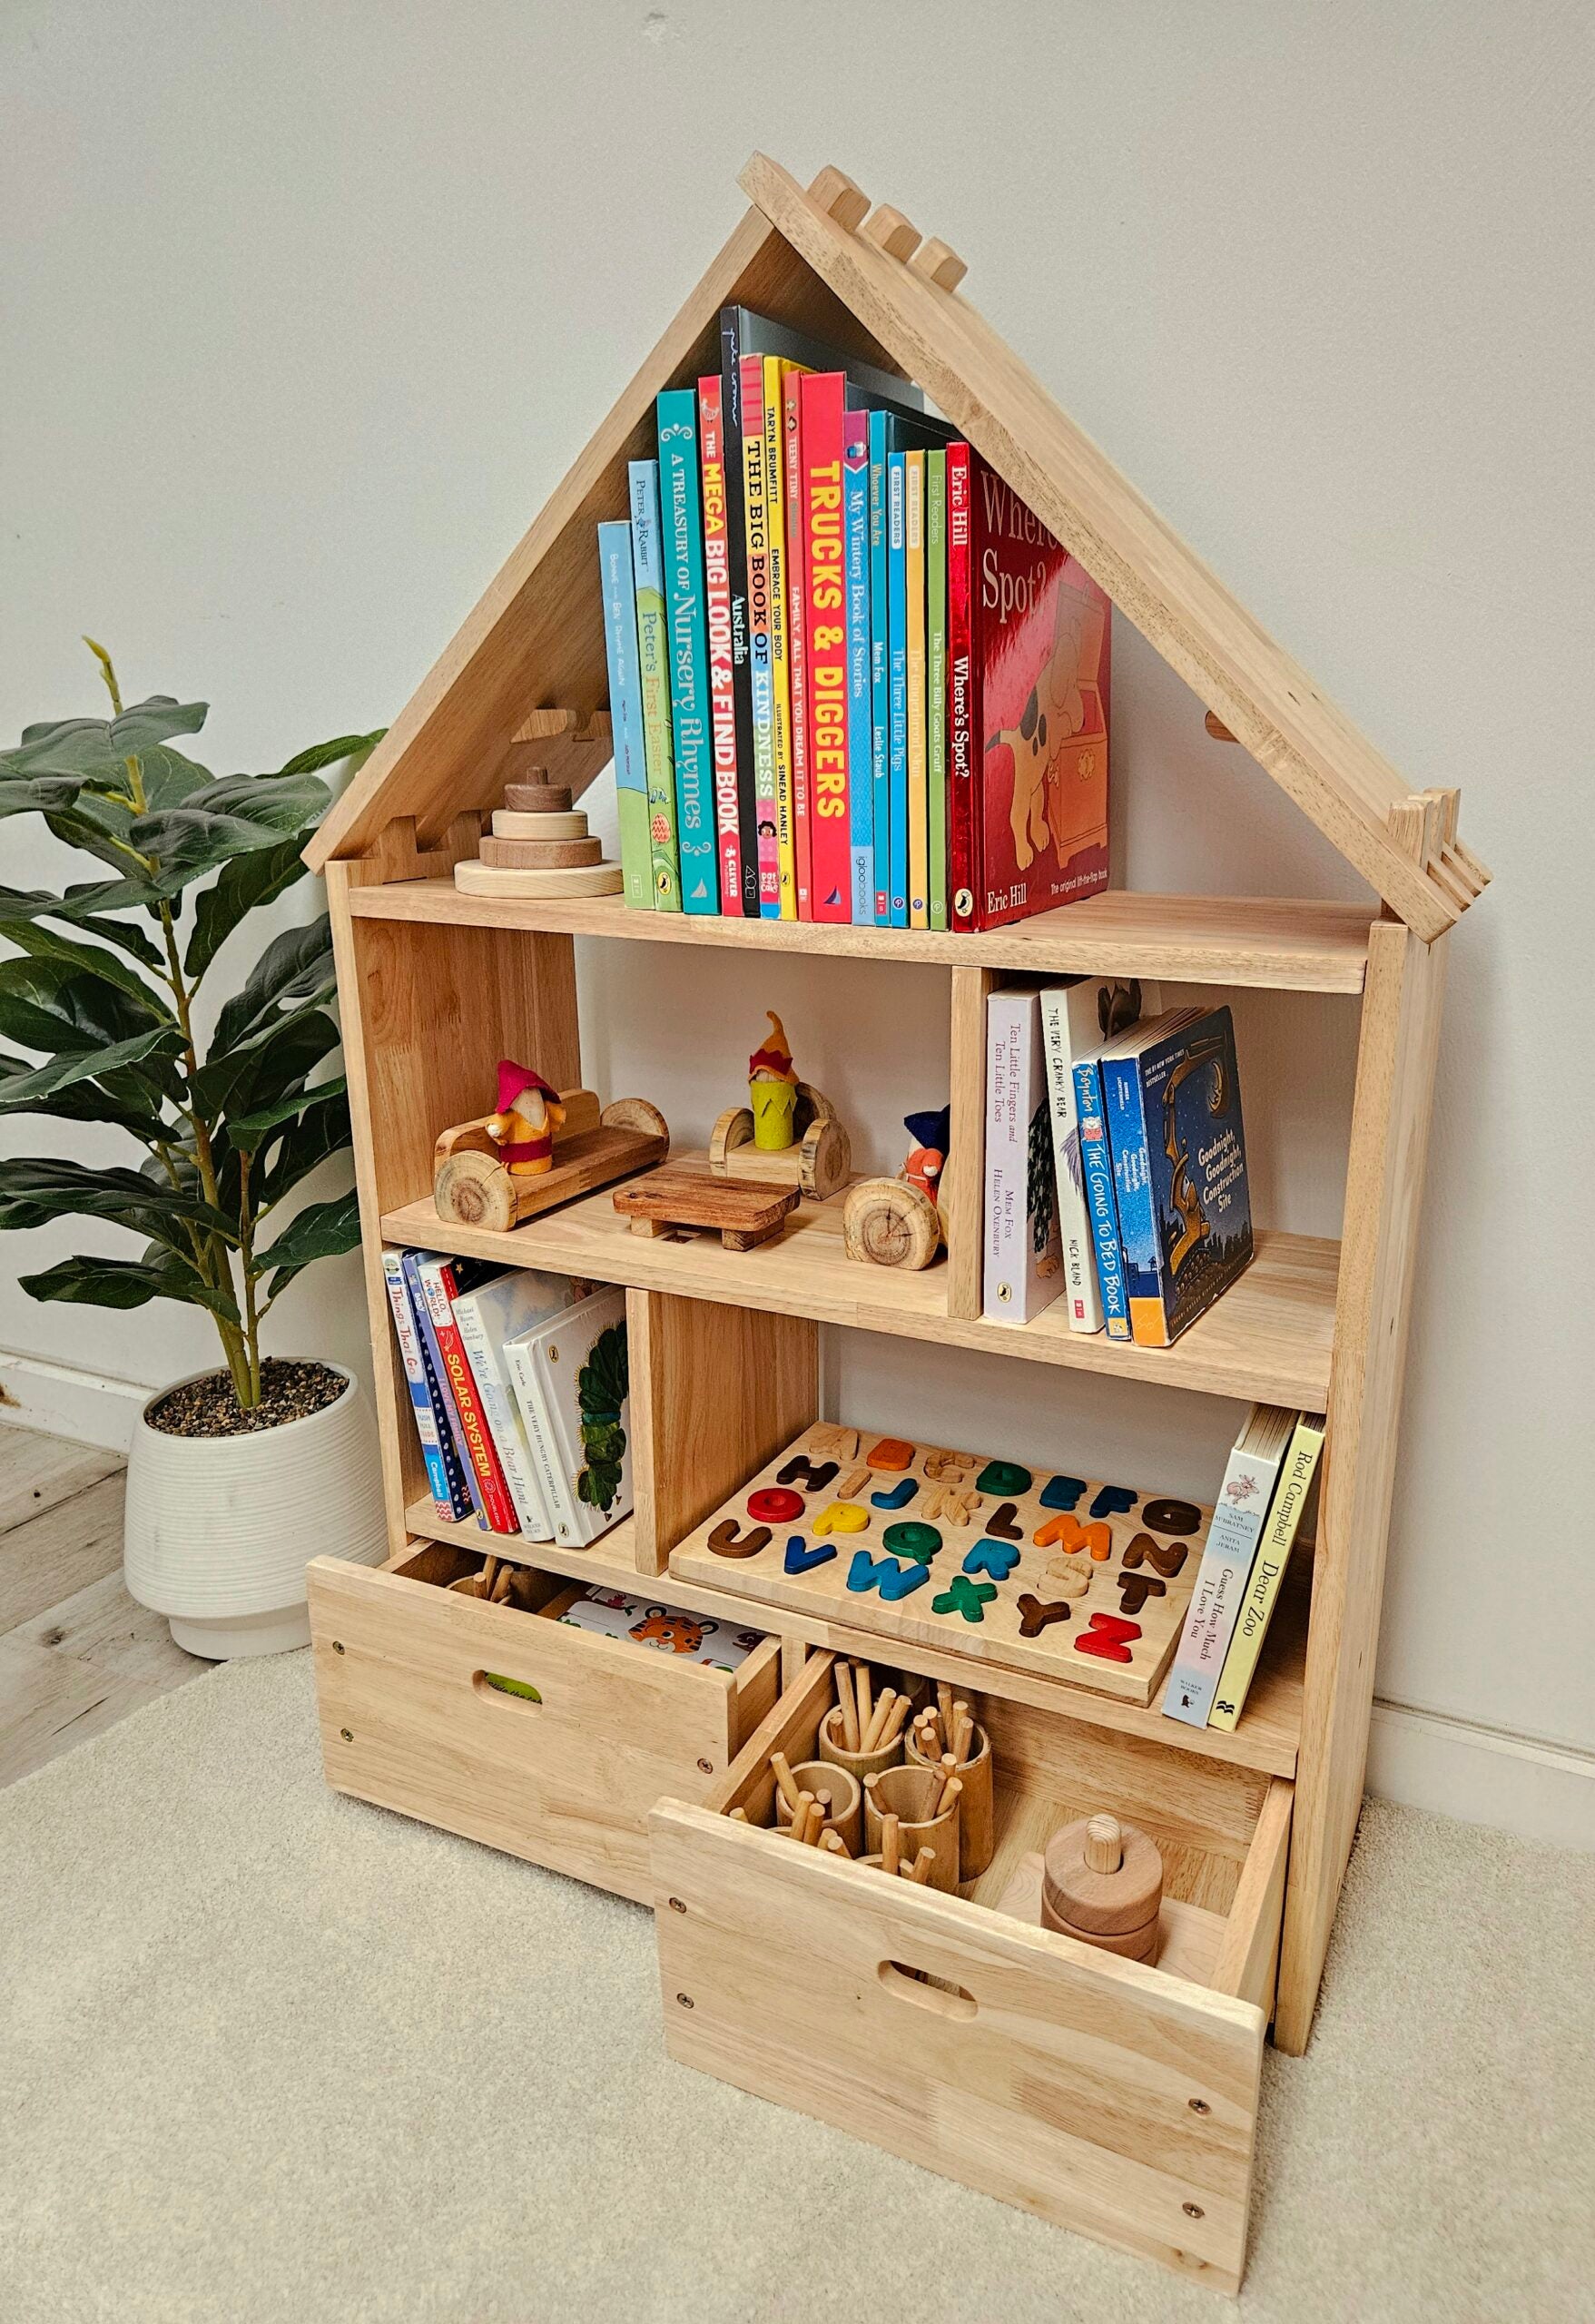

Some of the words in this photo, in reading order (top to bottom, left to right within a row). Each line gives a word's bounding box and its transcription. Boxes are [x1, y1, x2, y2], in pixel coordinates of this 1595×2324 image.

[767, 408, 776, 441] TARYN
[672, 454, 684, 465] A
[704, 431, 715, 458] THE
[788, 436, 797, 469] TEENY
[747, 441, 762, 497] THE
[769, 448, 778, 504] BRUMFITT
[871, 464, 882, 507] Whoever
[932, 475, 941, 496] First
[635, 480, 645, 516] PETER
[704, 464, 724, 535] MEGA
[789, 474, 798, 499] TINY
[850, 492, 863, 514] My
[952, 466, 967, 507] Eric
[672, 468, 690, 562] TREASURY
[751, 505, 763, 550] BIG
[872, 508, 882, 527] You
[932, 500, 941, 544] Readers
[953, 511, 968, 546] Hill
[639, 530, 648, 566] RABBIT
[810, 461, 842, 610] TRUCKS
[850, 517, 864, 579] Wintery
[872, 530, 882, 546] Are
[676, 567, 690, 590] OF
[704, 540, 727, 584] BIG
[772, 549, 780, 600] EMBRACE
[753, 556, 766, 626] BOOK
[983, 548, 1047, 624] Spot?
[852, 586, 864, 624] Book
[643, 612, 656, 672] Peter's
[708, 593, 732, 663] LOOK
[733, 594, 748, 665] Australia
[814, 625, 843, 651] &
[852, 632, 864, 642] of
[933, 631, 941, 650] The
[674, 593, 696, 712] Nursery
[754, 633, 767, 664] OF
[793, 639, 801, 663] ALL
[874, 642, 883, 664] Mem
[893, 648, 904, 672] The
[712, 665, 733, 690] &
[793, 667, 802, 697] THAT
[853, 648, 866, 698] Stories
[874, 667, 884, 684] Fox
[933, 654, 941, 683] Three
[645, 676, 659, 716] First
[893, 674, 904, 710] Three
[931, 686, 941, 710] Billy
[954, 656, 969, 726] Where's
[793, 701, 802, 724] YOU
[893, 713, 904, 744] Little
[713, 694, 736, 765] FIND
[755, 670, 773, 797] KINDNESS
[794, 725, 804, 767] DREAM
[814, 666, 846, 817] DIGGERS
[874, 726, 884, 752] Leslie
[648, 724, 661, 774] Easter
[891, 748, 904, 772] Pigs
[952, 731, 970, 778] Spot?
[675, 718, 704, 829] Rhymes
[795, 771, 803, 779] IT
[875, 754, 885, 778] Staub
[716, 772, 739, 836] BOOK
[777, 751, 783, 760] BY
[780, 806, 788, 845] HANLEY
[795, 784, 804, 800] TO
[796, 803, 805, 816] BE
[728, 860, 737, 898] CLEVER
[856, 856, 867, 915] igloobooks
[1059, 877, 1076, 892] original
[1098, 868, 1108, 880] book
[987, 890, 1008, 913] Eric
[1010, 883, 1027, 908] Hill
[1010, 1024, 1020, 1044] Ten
[1048, 1009, 1058, 1027] THE
[995, 1040, 1005, 1060] Ten
[1050, 1030, 1060, 1053] VERY
[1009, 1047, 1020, 1078] Little
[1053, 1058, 1065, 1093] CRANKY
[995, 1064, 1005, 1095] Little
[1077, 1068, 1094, 1112] Boynton
[994, 1098, 1005, 1123] Toes
[1007, 1082, 1019, 1122] Fingers
[1057, 1097, 1067, 1118] BEAR
[1009, 1125, 1018, 1143] and
[1199, 1128, 1235, 1167] Goodnight,
[1087, 1143, 1105, 1171] THE
[1206, 1144, 1241, 1182] Goodnight,
[993, 1169, 1002, 1202] HELEN
[1090, 1172, 1108, 1216] GOING
[1204, 1163, 1244, 1205] Construction
[1005, 1190, 1014, 1215] MEM
[1218, 1194, 1231, 1213] Site
[992, 1206, 1002, 1257] OXENBURY
[1005, 1218, 1013, 1239] FOX
[1098, 1220, 1112, 1237] TO
[1069, 1239, 1078, 1258] NICK
[1100, 1238, 1118, 1271] BED
[1071, 1262, 1081, 1286] BLAND
[1104, 1273, 1121, 1315] BOOK
[392, 1287, 405, 1324] Things
[400, 1326, 411, 1353] That
[407, 1357, 417, 1374] Go
[448, 1354, 472, 1408] SOLAR
[464, 1412, 490, 1477] SYSTEM
[473, 1350, 487, 1378] We're
[503, 1446, 517, 1473] Bear
[512, 1475, 528, 1503] Hunt
[531, 1415, 540, 1433] VERY
[537, 1434, 546, 1460] HUNGRY
[543, 1462, 560, 1509] CATERPILLAR
[1293, 1452, 1313, 1480] Rod
[431, 1462, 443, 1497] Campbell
[489, 1494, 501, 1526] DOUBLEDAY
[747, 1488, 805, 1523] O
[812, 1502, 870, 1536] P
[882, 1521, 942, 1565] Q
[1272, 1482, 1303, 1546] Campbell
[1033, 1514, 1111, 1561] M
[707, 1519, 773, 1559] U
[784, 1536, 837, 1574] V
[847, 1551, 930, 1600] W
[931, 1576, 997, 1622] X
[1074, 1613, 1142, 1663] Z
[1217, 1569, 1233, 1600] Guess
[1254, 1561, 1279, 1604] Dear
[1197, 1590, 1213, 1614] Love
[1209, 1603, 1225, 1629] How
[1191, 1620, 1206, 1639] You
[1243, 1607, 1265, 1637] Zoo
[1200, 1631, 1216, 1659] Much
